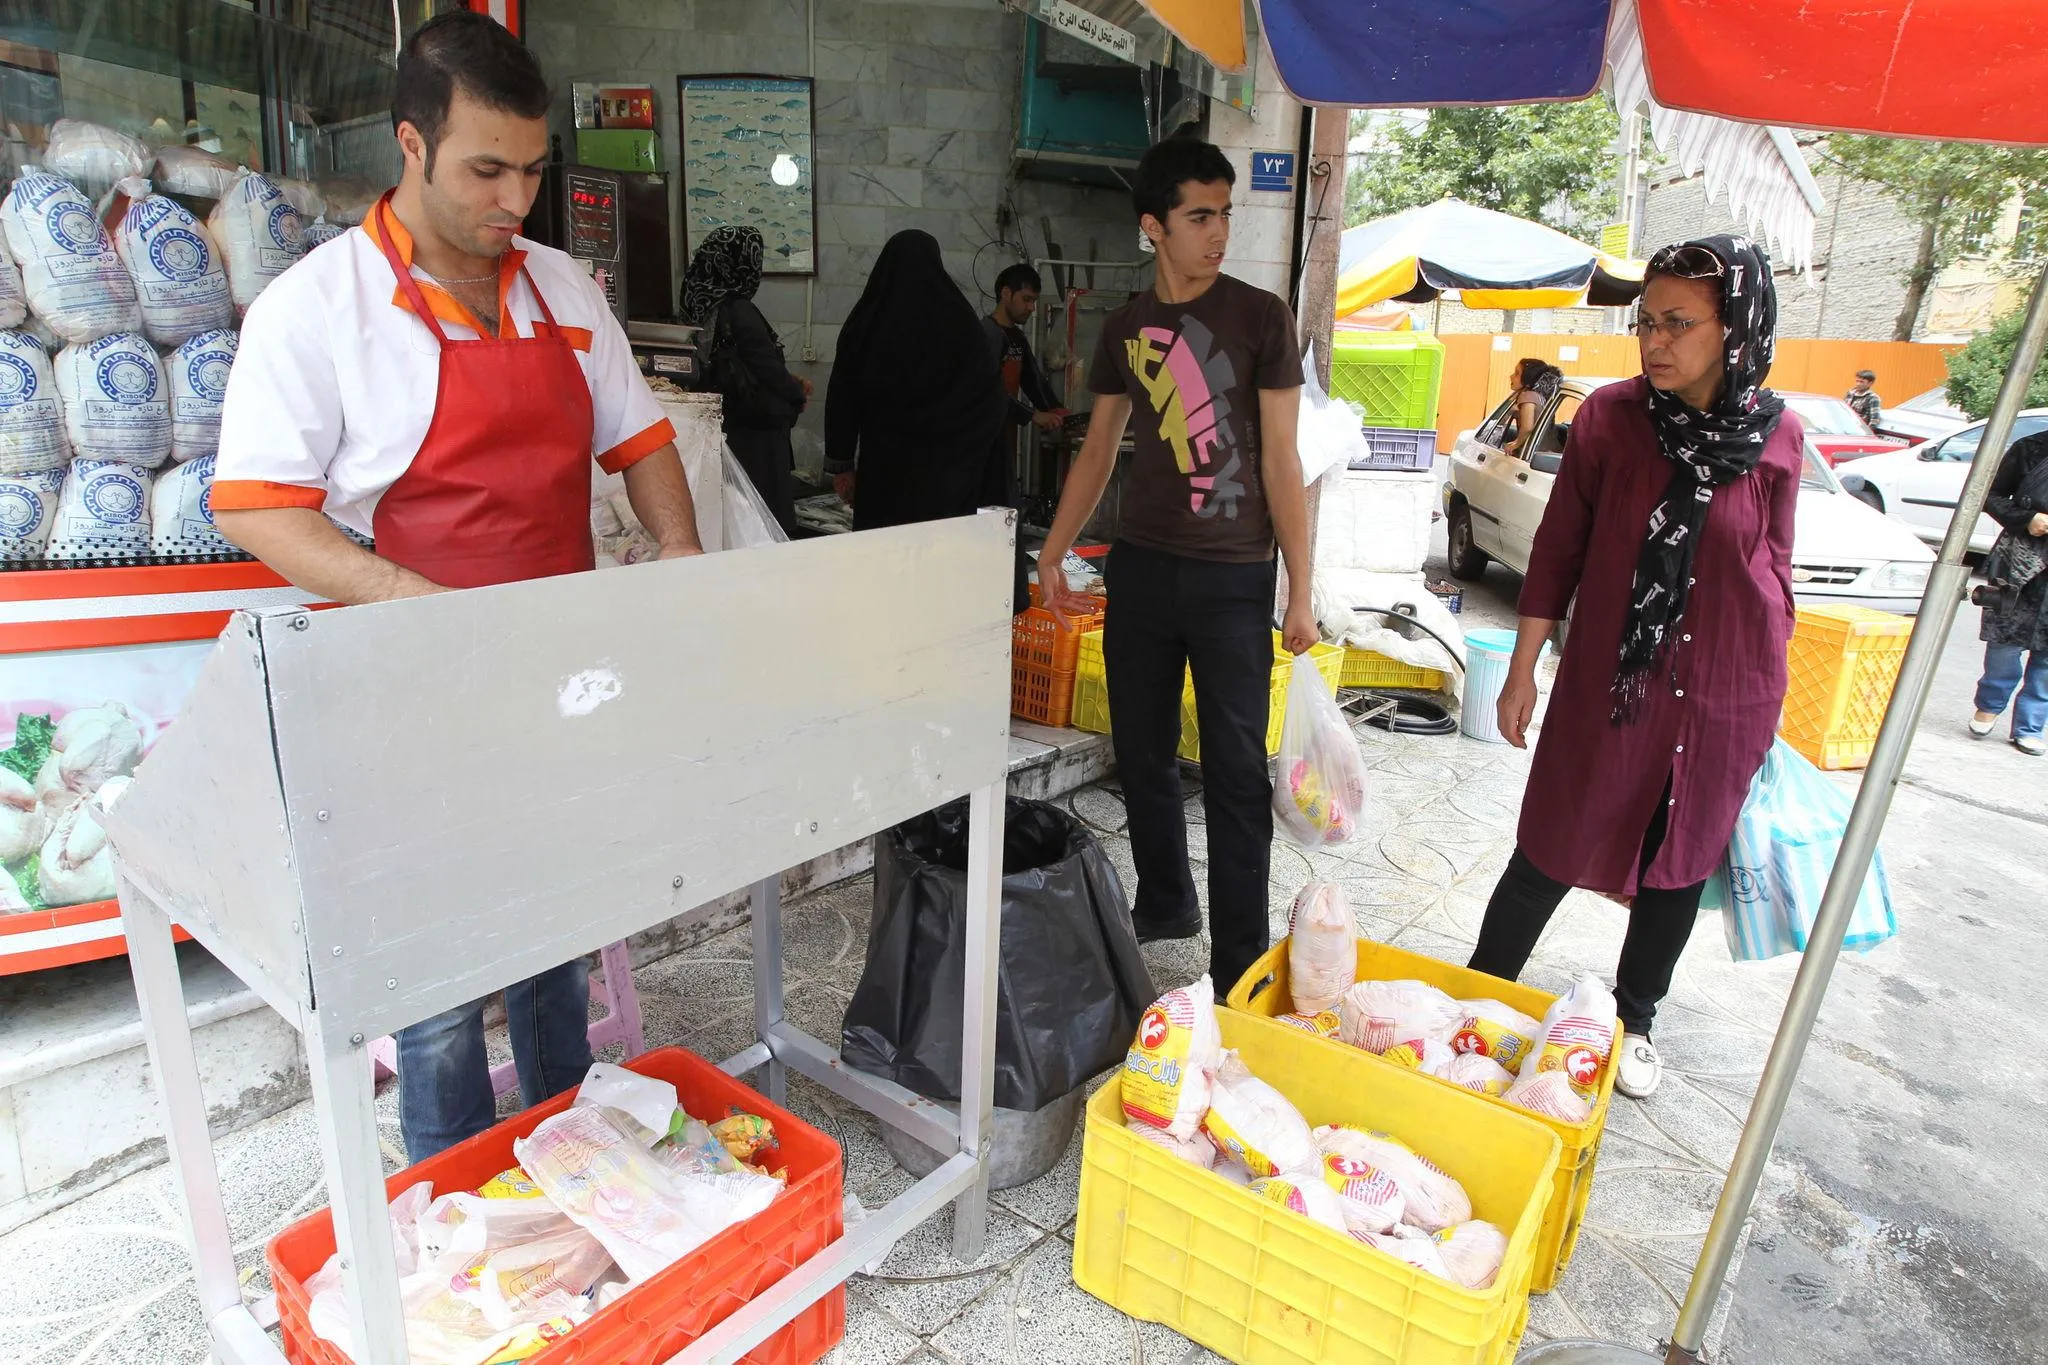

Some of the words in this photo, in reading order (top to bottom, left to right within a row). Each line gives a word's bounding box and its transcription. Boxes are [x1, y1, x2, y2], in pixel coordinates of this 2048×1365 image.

[1058, 11, 1077, 27] الفرج
[1263, 158, 1285, 173] ۷۳
[175, 269, 199, 277] KISOM
[193, 279, 208, 288] تازه
[137, 404, 154, 414] تازه
[1149, 1057, 1181, 1088] بابل
